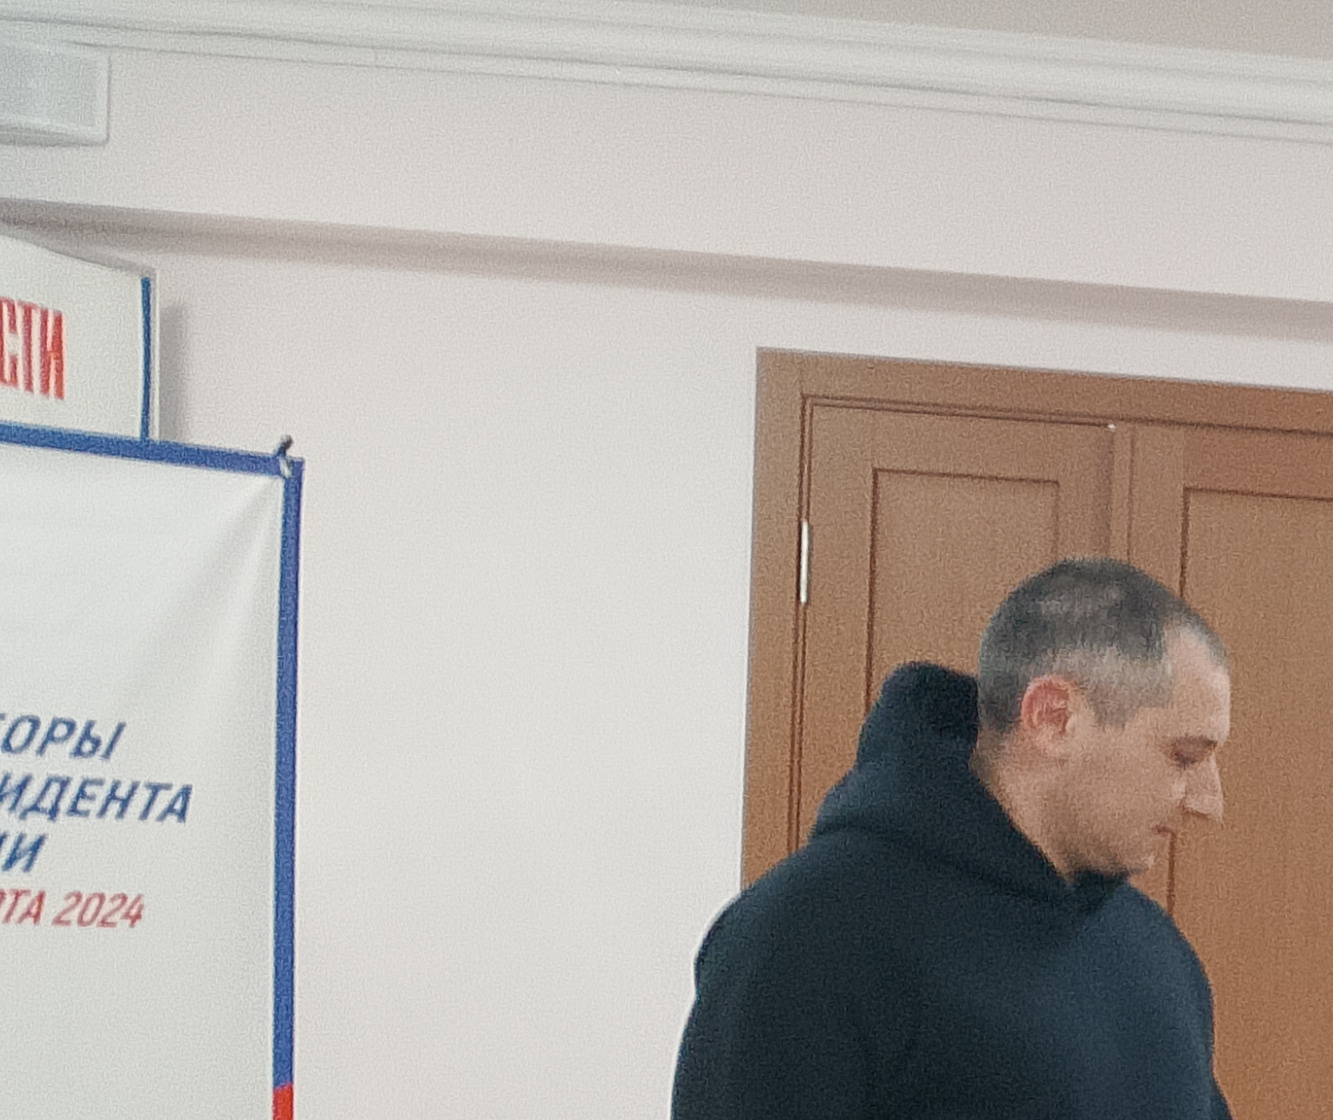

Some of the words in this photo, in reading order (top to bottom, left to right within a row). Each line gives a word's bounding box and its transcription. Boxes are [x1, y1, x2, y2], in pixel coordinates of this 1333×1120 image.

[0, 712, 127, 760] ОРЫ
[0, 831, 47, 873] И
[52, 890, 145, 928] 2024
